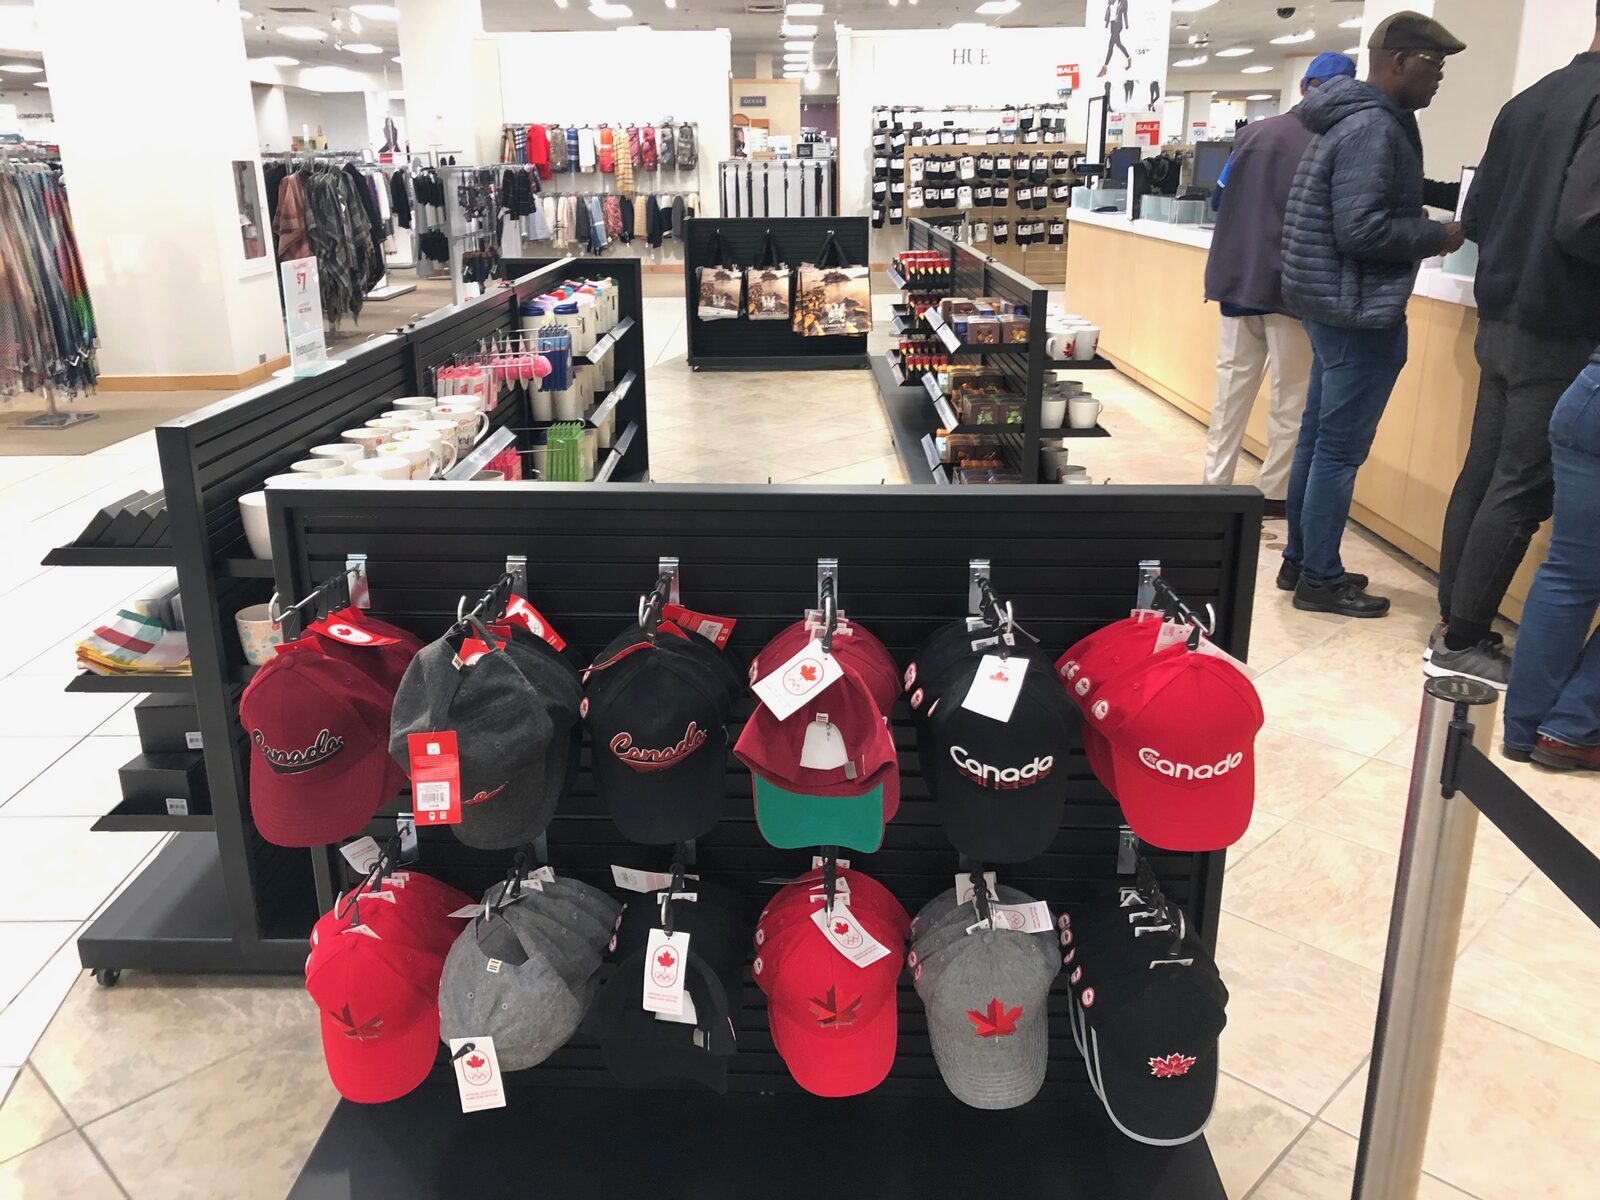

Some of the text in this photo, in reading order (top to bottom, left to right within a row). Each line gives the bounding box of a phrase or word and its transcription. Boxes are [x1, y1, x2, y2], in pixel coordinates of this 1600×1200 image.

[952, 48, 991, 65] HUE
[1136, 123, 1160, 131] SALE
[252, 728, 345, 766] Canada
[609, 720, 708, 763] Canada
[949, 745, 1054, 783] Canada
[1138, 747, 1244, 781] Canada
